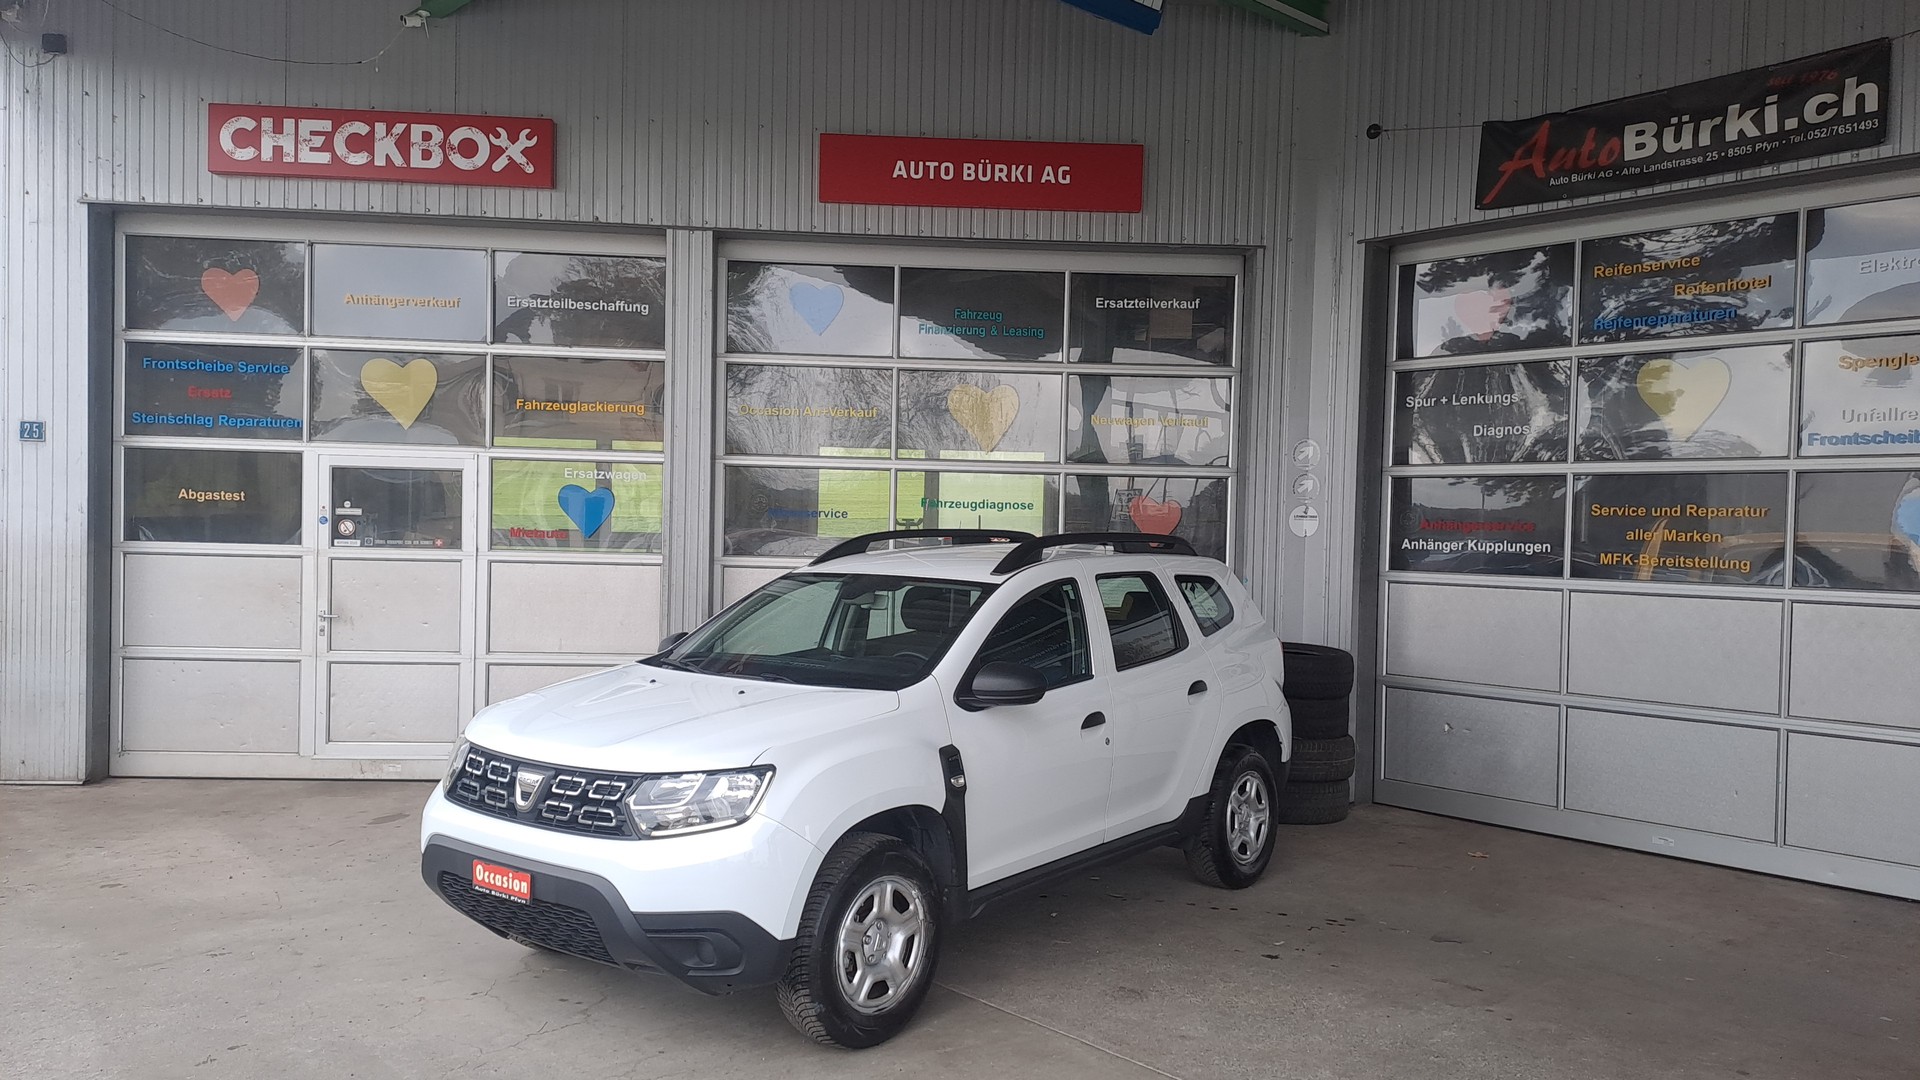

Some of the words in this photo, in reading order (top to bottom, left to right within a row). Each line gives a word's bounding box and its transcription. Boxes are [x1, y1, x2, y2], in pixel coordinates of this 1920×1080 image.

[893, 159, 954, 180] AUTO
[963, 160, 1033, 183] BÜRKI
[1041, 166, 1071, 184] AG
[1549, 176, 1569, 187] Auto
[1571, 171, 1596, 184] Bürki
[1597, 169, 1614, 180] AG
[1621, 166, 1640, 176] Alte
[1643, 155, 1703, 173] Landstrasse
[1705, 151, 1719, 163] 25
[1727, 145, 1753, 159] 8505
[1755, 139, 1779, 156] Pfyn
[1593, 256, 1702, 279] Reifenservice
[1674, 275, 1772, 299] Reifenhotel
[343, 292, 462, 309] Anhängerverkauf
[507, 295, 650, 315] Ersatzteilbeschaffung
[1095, 297, 1200, 310] Ersatzteilverkauf
[954, 308, 1002, 323] Fahrzeug
[1593, 306, 1738, 330] Reifenreparaturen
[918, 322, 987, 337] Finanzierung
[990, 326, 999, 337] &
[1002, 325, 1044, 340] Leasing
[143, 357, 234, 373] Frontscheibe
[238, 360, 290, 375] Service
[188, 385, 233, 400] Ersatz
[1406, 395, 1437, 410] Spur
[1440, 396, 1448, 405] +
[1452, 391, 1519, 407] Lenkungs
[516, 397, 645, 416] Fahrzeuglackierung
[739, 403, 799, 416] Occasion
[132, 411, 213, 429] Steinschlag
[218, 414, 303, 429] Reparaturen
[1091, 414, 1155, 428] Neuwagen
[1160, 415, 1209, 428] Verkauf
[1843, 407, 1918, 424] Unfallre
[24, 422, 39, 438] 25
[564, 467, 647, 483] Ersatzwagen
[178, 488, 246, 504] Abgastest
[921, 498, 1034, 514] Fahrzeugdiagnose
[1591, 504, 1647, 518] Service
[1651, 505, 1681, 518] und
[1686, 505, 1767, 520] Reparatur
[1626, 529, 1658, 542] aller
[1663, 530, 1723, 544] Marken
[1401, 539, 1463, 555] Anhänger
[1467, 540, 1552, 557] Kupplungen
[1600, 553, 1752, 574] MFK-Bereitstellung
[476, 864, 528, 894] Occasion
[474, 885, 489, 894] Auto
